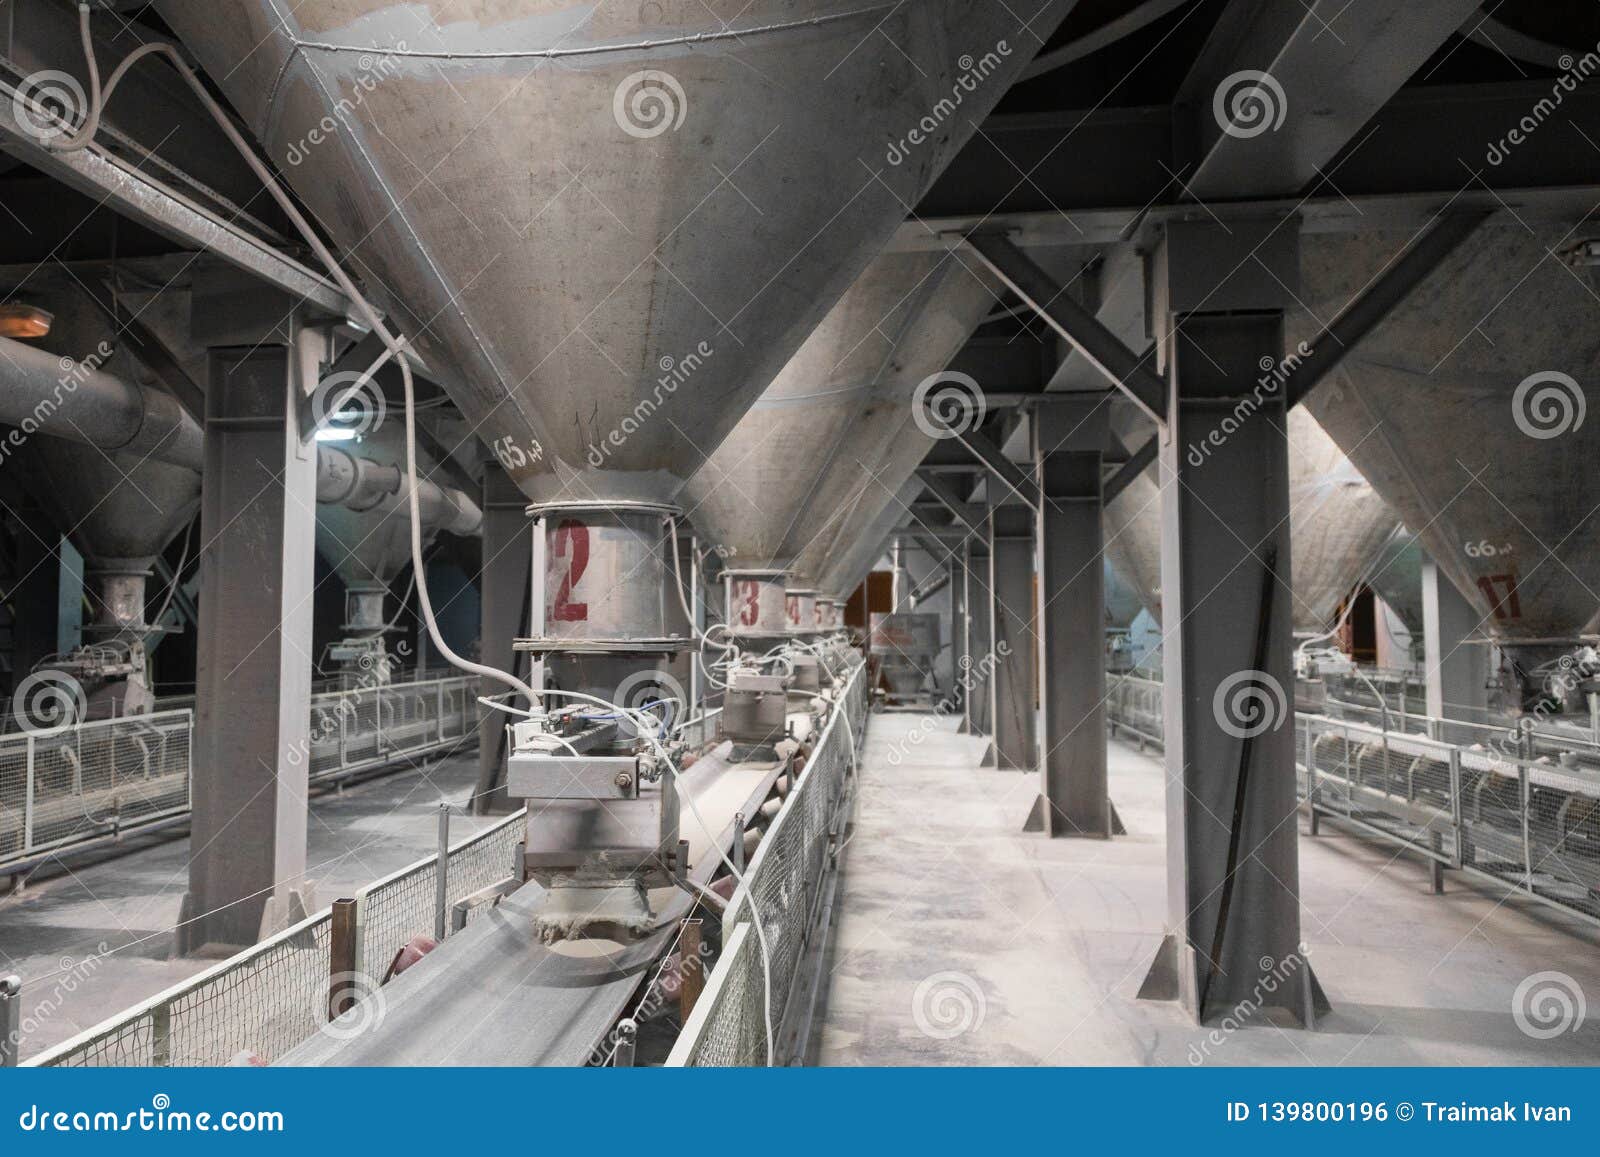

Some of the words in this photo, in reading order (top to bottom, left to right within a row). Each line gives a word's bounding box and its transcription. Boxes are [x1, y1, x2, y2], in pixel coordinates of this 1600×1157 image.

[493, 435, 527, 470] 65
[1464, 540, 1496, 558] 66
[1476, 574, 1521, 620] 17
